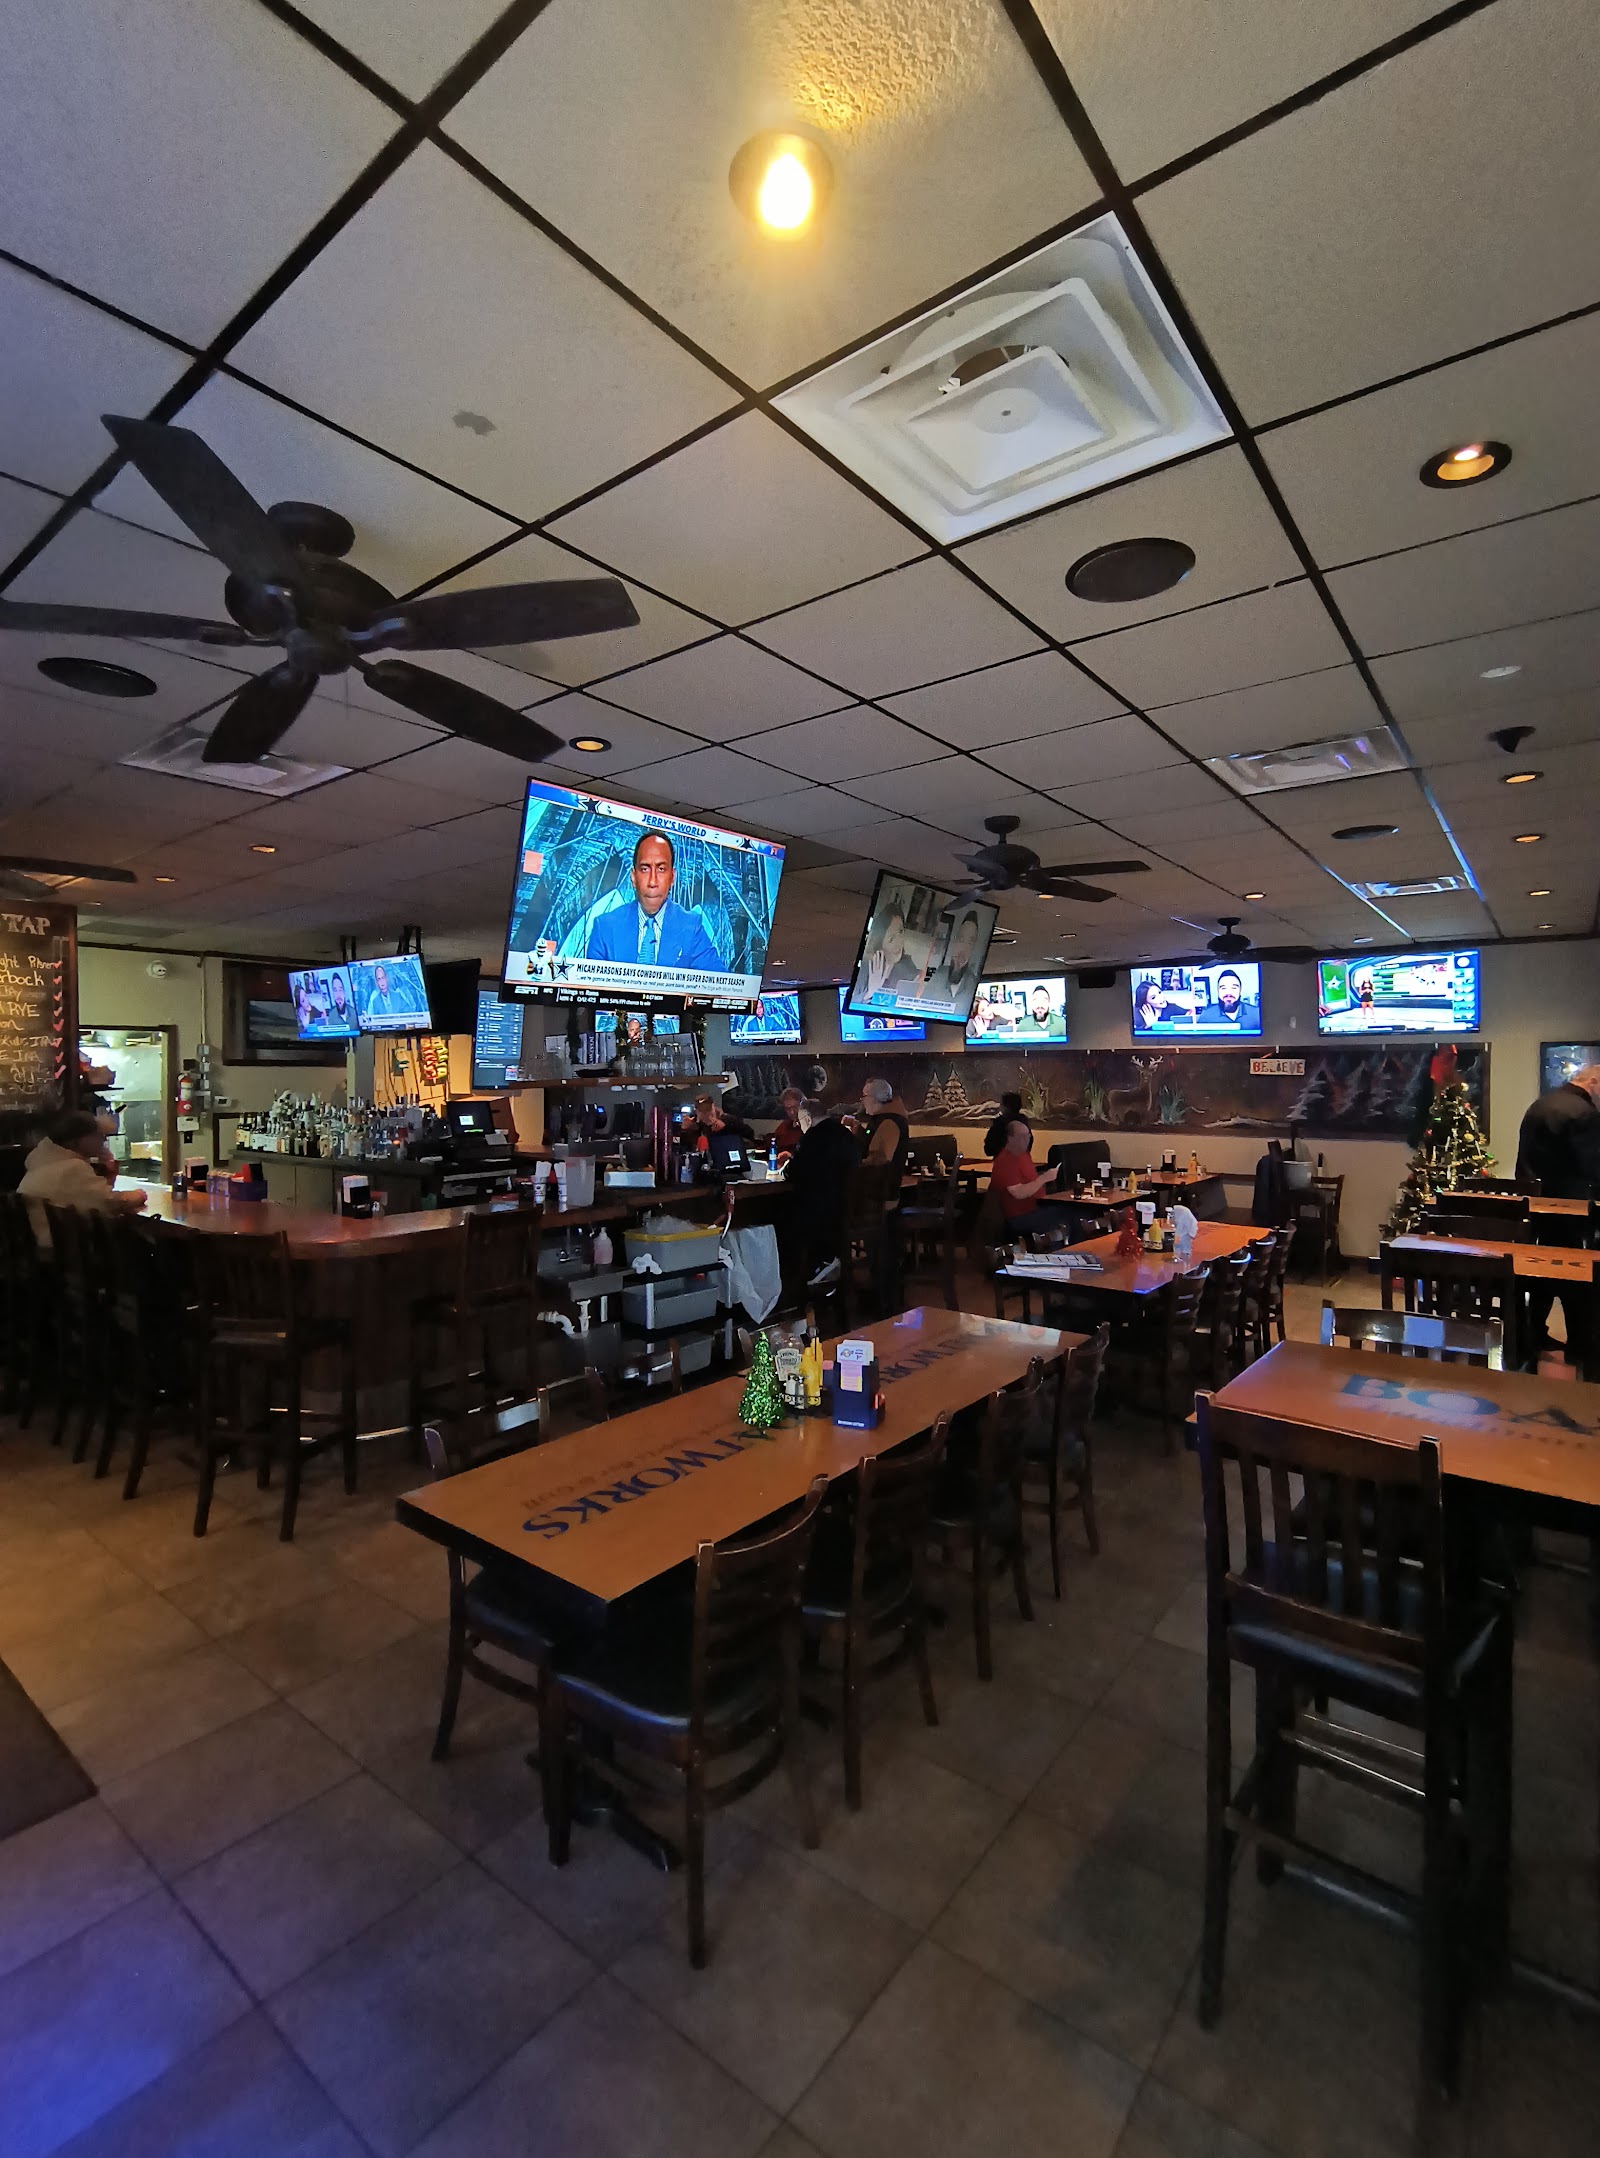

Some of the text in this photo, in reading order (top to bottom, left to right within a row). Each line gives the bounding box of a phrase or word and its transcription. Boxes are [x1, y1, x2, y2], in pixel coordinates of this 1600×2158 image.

[642, 814, 707, 838] JERRY'S WORLD
[1, 913, 51, 936] TAP
[576, 963, 746, 986] MICAH PARSONS SAYS COWBOYS WILL WIN SUPER BOWL NEXT SEASON
[560, 987, 578, 996] Vikings
[7, 1001, 40, 1017] RYE
[1252, 1060, 1304, 1075] BELIEVE
